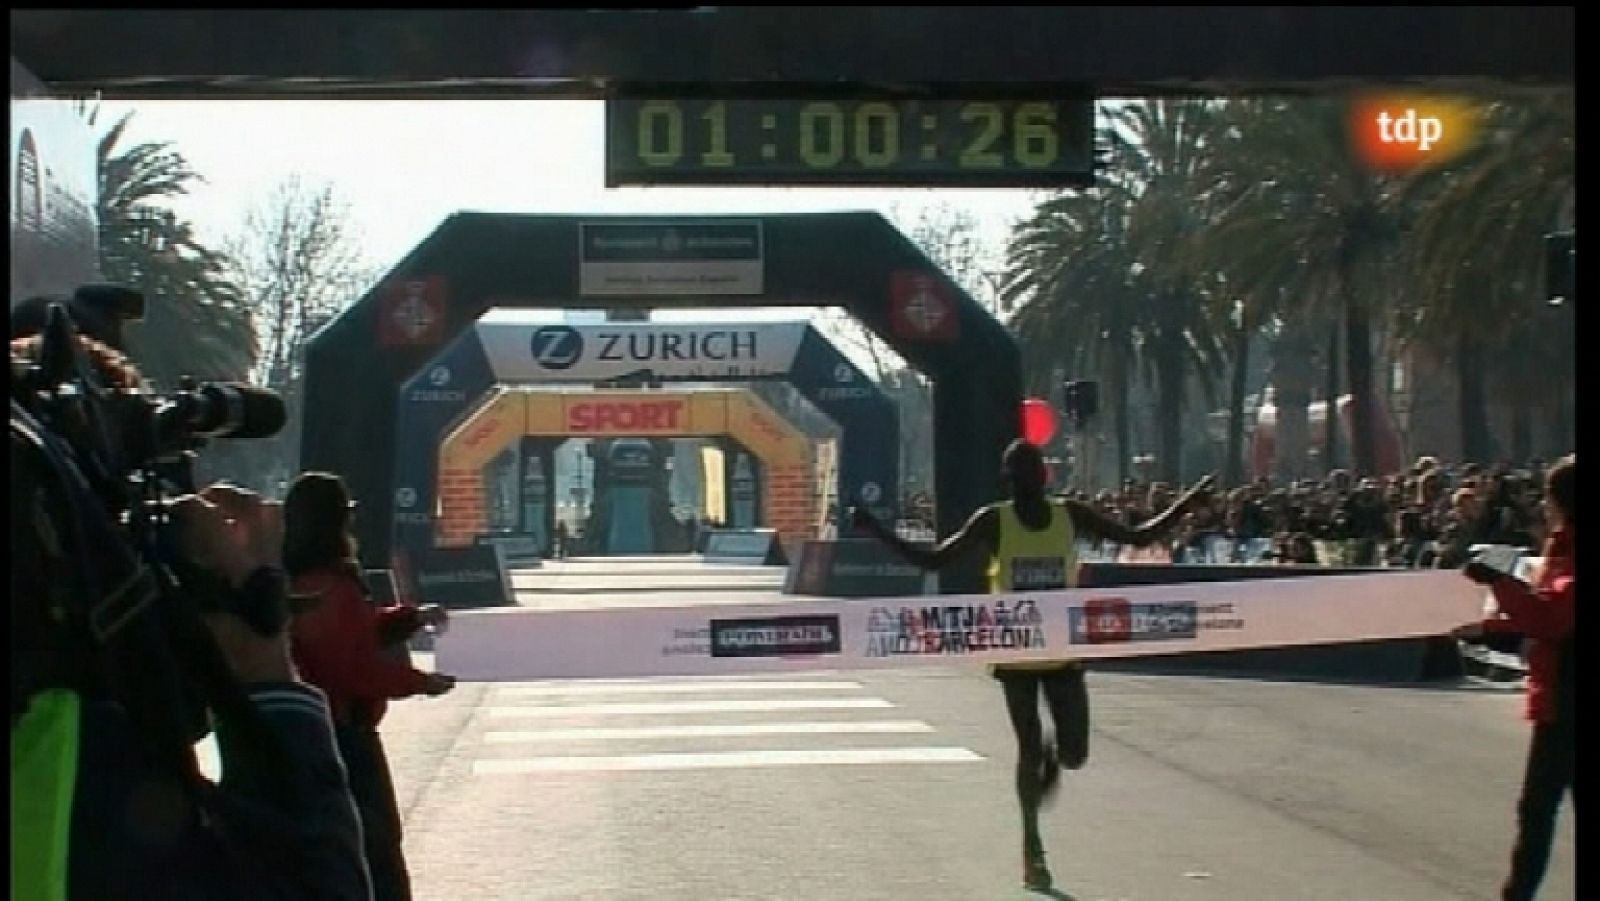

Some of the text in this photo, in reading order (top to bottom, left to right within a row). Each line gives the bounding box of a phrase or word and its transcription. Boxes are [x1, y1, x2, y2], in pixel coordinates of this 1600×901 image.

[637, 102, 1060, 168] 01:00:26
[597, 331, 758, 361] ZURICH
[569, 400, 682, 431] SPORT
